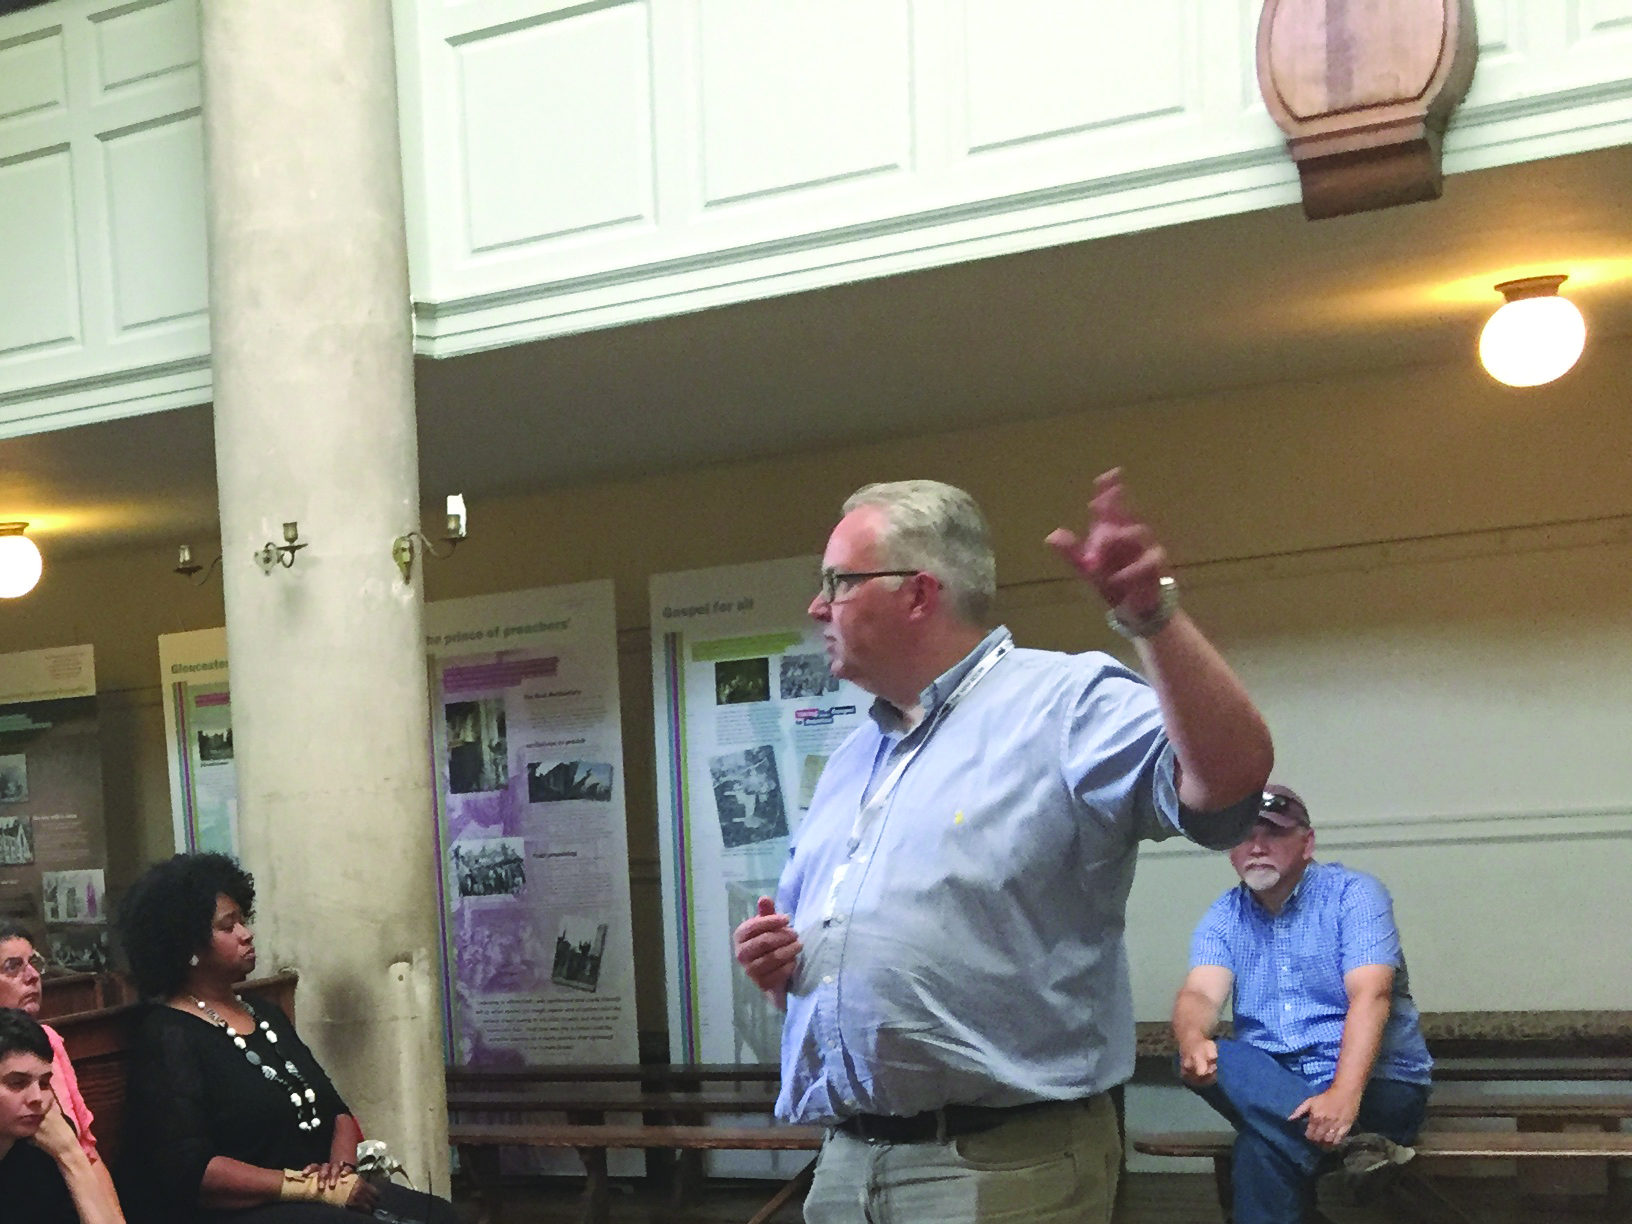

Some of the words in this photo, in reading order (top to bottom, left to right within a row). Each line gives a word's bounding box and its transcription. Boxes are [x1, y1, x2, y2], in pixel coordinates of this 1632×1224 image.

[662, 602, 710, 619] Gospel
[712, 599, 734, 613] for
[736, 596, 754, 611] all
[443, 630, 484, 646] prince
[485, 626, 500, 639] of
